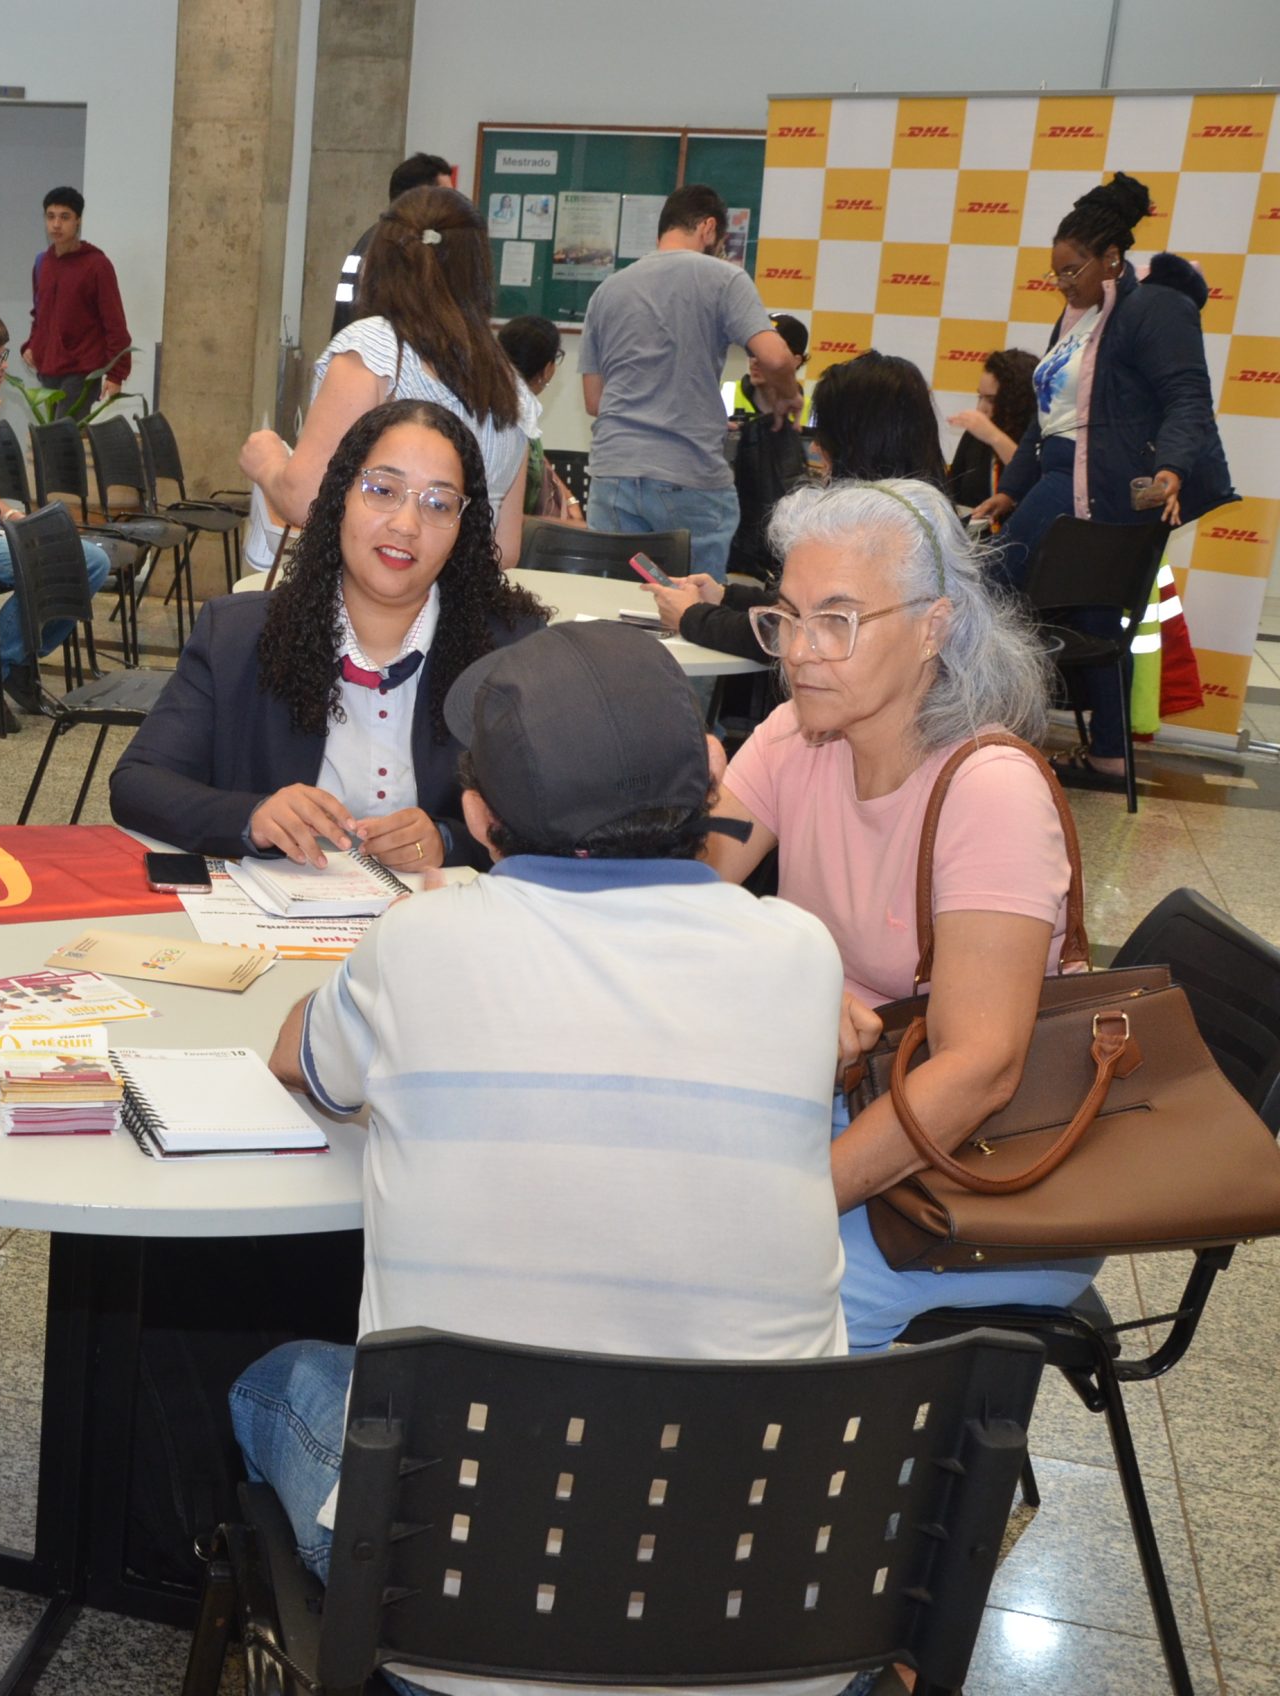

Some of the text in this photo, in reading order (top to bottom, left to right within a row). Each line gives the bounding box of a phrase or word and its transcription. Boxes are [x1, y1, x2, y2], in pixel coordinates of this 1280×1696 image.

[777, 126, 817, 138] DHL
[907, 126, 950, 138] DHL
[1048, 126, 1095, 138] DHL
[1201, 125, 1254, 138] DHL
[502, 156, 551, 168] Mestrado
[834, 199, 874, 211] DHL
[967, 202, 1010, 214] DHL
[765, 268, 804, 280] DHL
[890, 273, 932, 286] DHL
[819, 341, 858, 354] DHL
[1210, 527, 1260, 543] DHL
[1200, 683, 1230, 698] HL
